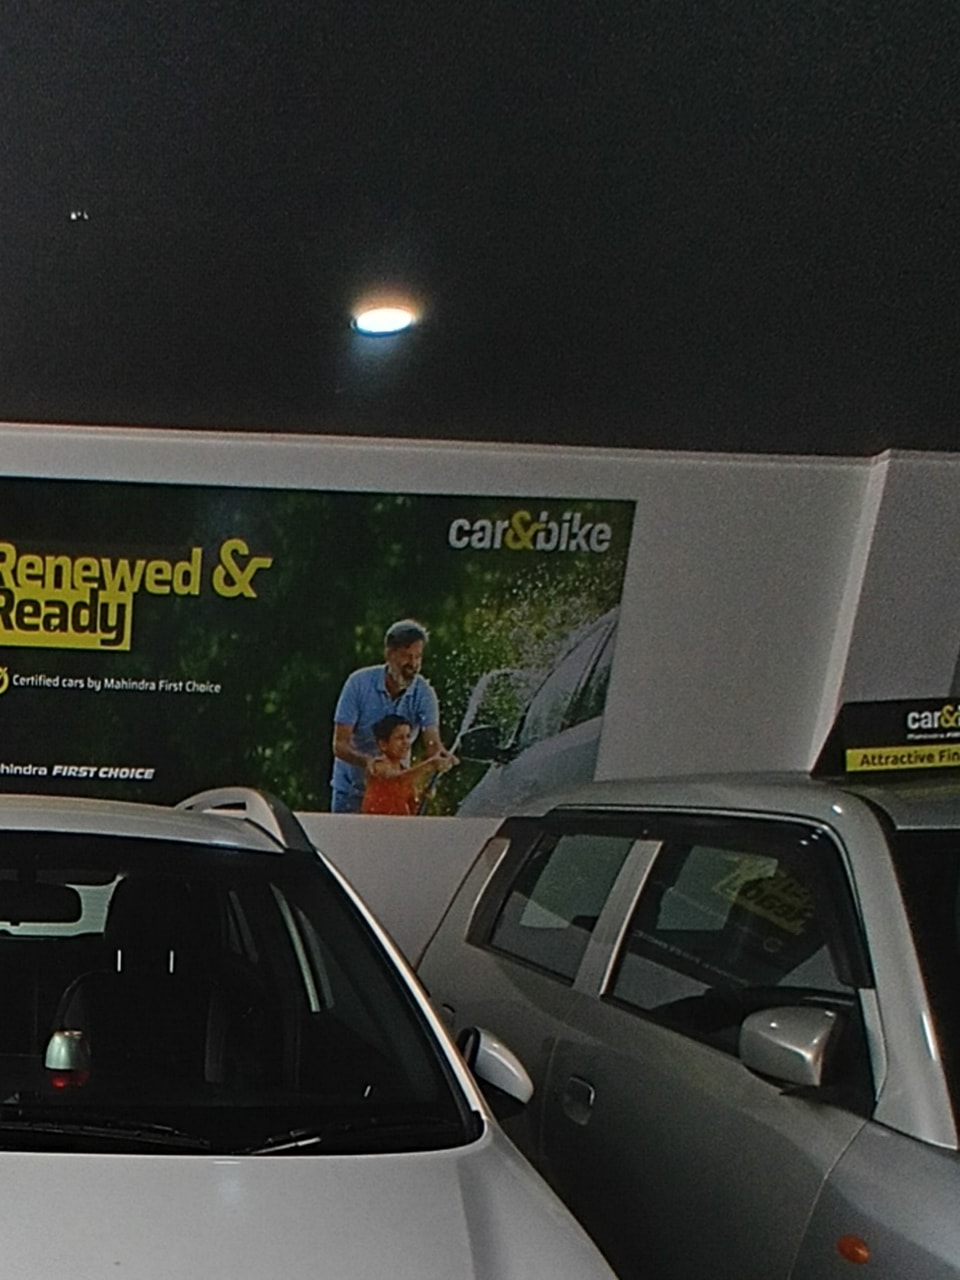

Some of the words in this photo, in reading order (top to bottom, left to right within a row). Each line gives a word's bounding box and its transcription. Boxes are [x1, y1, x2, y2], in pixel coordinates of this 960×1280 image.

[448, 510, 612, 553] car&bike
[212, 538, 273, 598] &
[12, 674, 60, 688] Certified
[61, 677, 85, 689] cars
[87, 678, 102, 692] by
[104, 678, 157, 691] Mahindra
[158, 679, 184, 692] First
[185, 680, 222, 694] Choice
[907, 704, 960, 729] car&
[859, 750, 935, 767] Attractive
[51, 765, 98, 778] FIRST
[98, 767, 156, 780] CHOICE
